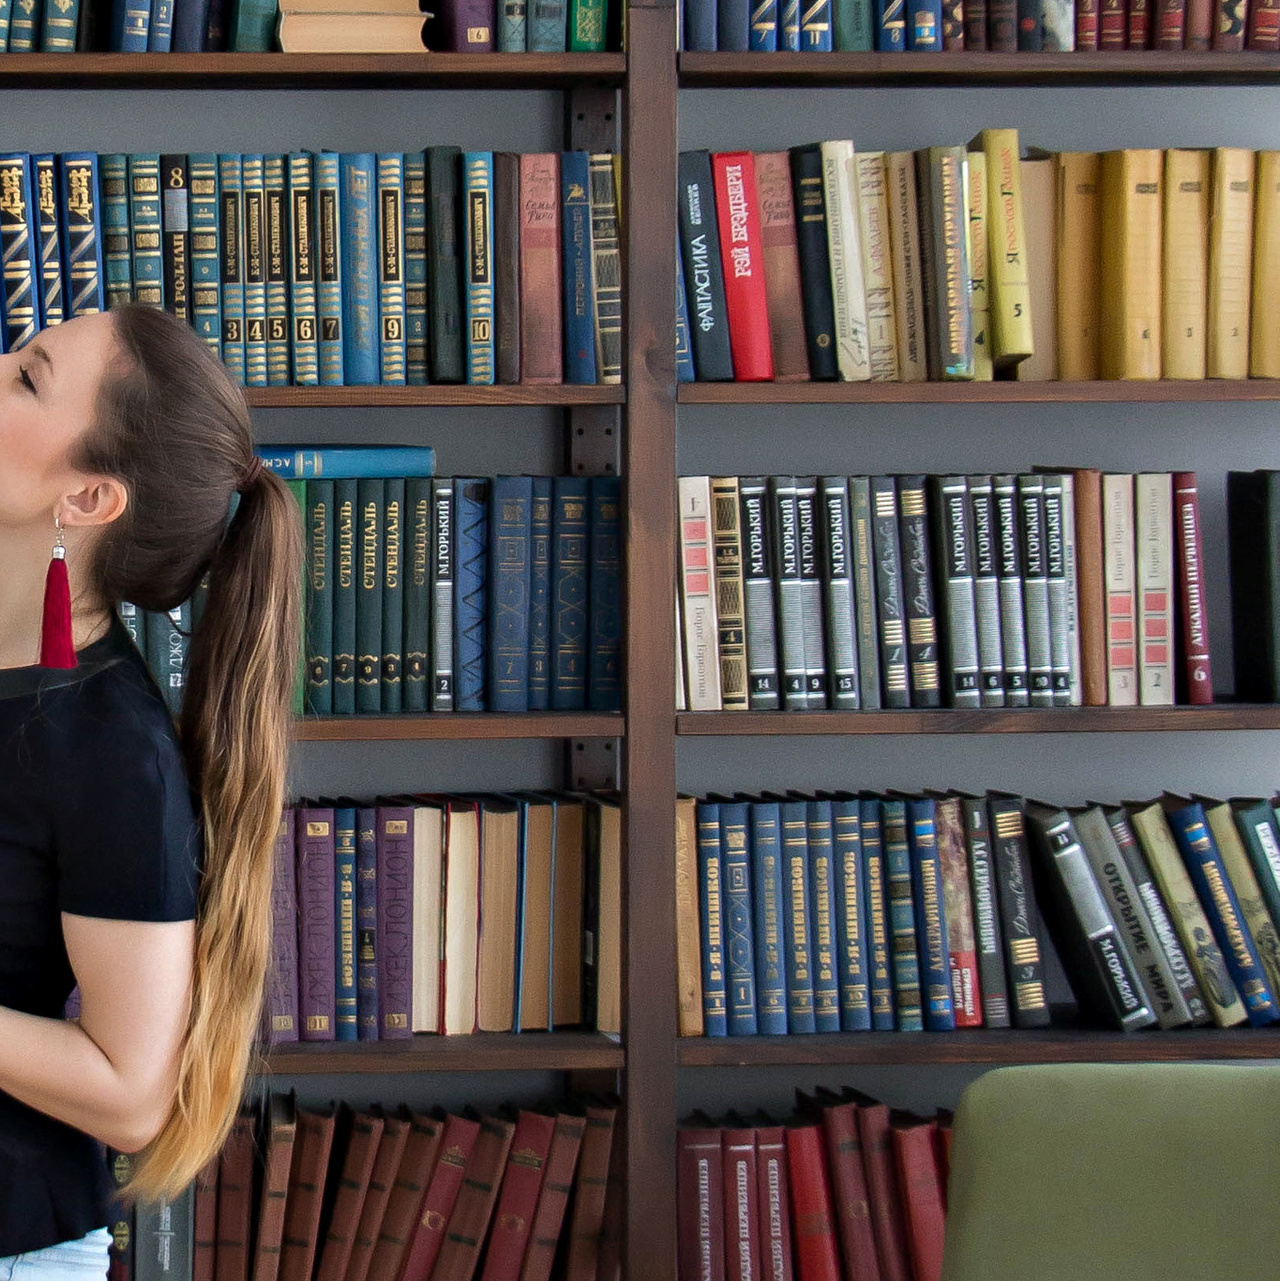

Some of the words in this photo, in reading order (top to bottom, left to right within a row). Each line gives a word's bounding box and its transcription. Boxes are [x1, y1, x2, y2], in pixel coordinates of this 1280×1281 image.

[170, 167, 183, 187] 8
[726, 165, 748, 242] БРЭДБЕРИ
[942, 156, 959, 245] СТРУГАЦКИХ
[173, 234, 185, 302] РОЛЛАН
[691, 235, 715, 332] ФАНТАСТИКА
[731, 247, 752, 278] РЭЙ
[946, 248, 961, 307] БРАТЬЕВ
[227, 322, 238, 340] 3
[249, 320, 262, 340] 4
[272, 319, 284, 339] 5
[301, 320, 312, 339] 6
[323, 320, 336, 339] 7
[386, 319, 398, 339] 9
[473, 320, 489, 340] 10
[949, 310, 962, 355] МИРЫ
[975, 330, 985, 345] 4
[1013, 303, 1022, 318] 5
[313, 502, 326, 590] СТЕНДАЛЬ
[340, 501, 353, 587] СТЕНДАЛЬ
[363, 502, 377, 589] СТЕНДАЛЬ
[386, 501, 400, 588] СТЕНДАЛЬ
[413, 500, 428, 586] СТЕНДАЛЬ
[435, 500, 451, 575] М.ГОРЬКИЙ
[747, 498, 764, 573] М.ГОРЬКИЙ
[780, 499, 797, 574] М.ГОРЬКИЙ
[798, 499, 815, 574] М.ГОРЬКИЙ
[828, 498, 846, 573] М.ГОРЬКИЙ
[949, 497, 966, 572] М.ГОРЬКИЙ
[974, 497, 992, 571] М.ГОРЬКИЙ
[1000, 498, 1016, 572] М.ГОРЬКИЙ
[1025, 498, 1041, 572] М.ГОРЬКИЙ
[1046, 498, 1062, 572] М.ГОРЬКИЙ
[1182, 503, 1198, 581] ПЕРВЕНЦЕВ
[1187, 584, 1204, 647] АРКАДИЙ
[439, 680, 449, 690] 2
[384, 839, 408, 941] ЛОНДОН
[1103, 862, 1149, 952] ОТКРЫТИЕ
[1147, 964, 1174, 1014] МИРА
[698, 1159, 711, 1238] ПЕРВЕНЦЕВ
[737, 1161, 749, 1238] ПЕРВЕНЦЕВ
[768, 1159, 782, 1237] ПЕРВЕНЦЕВ
